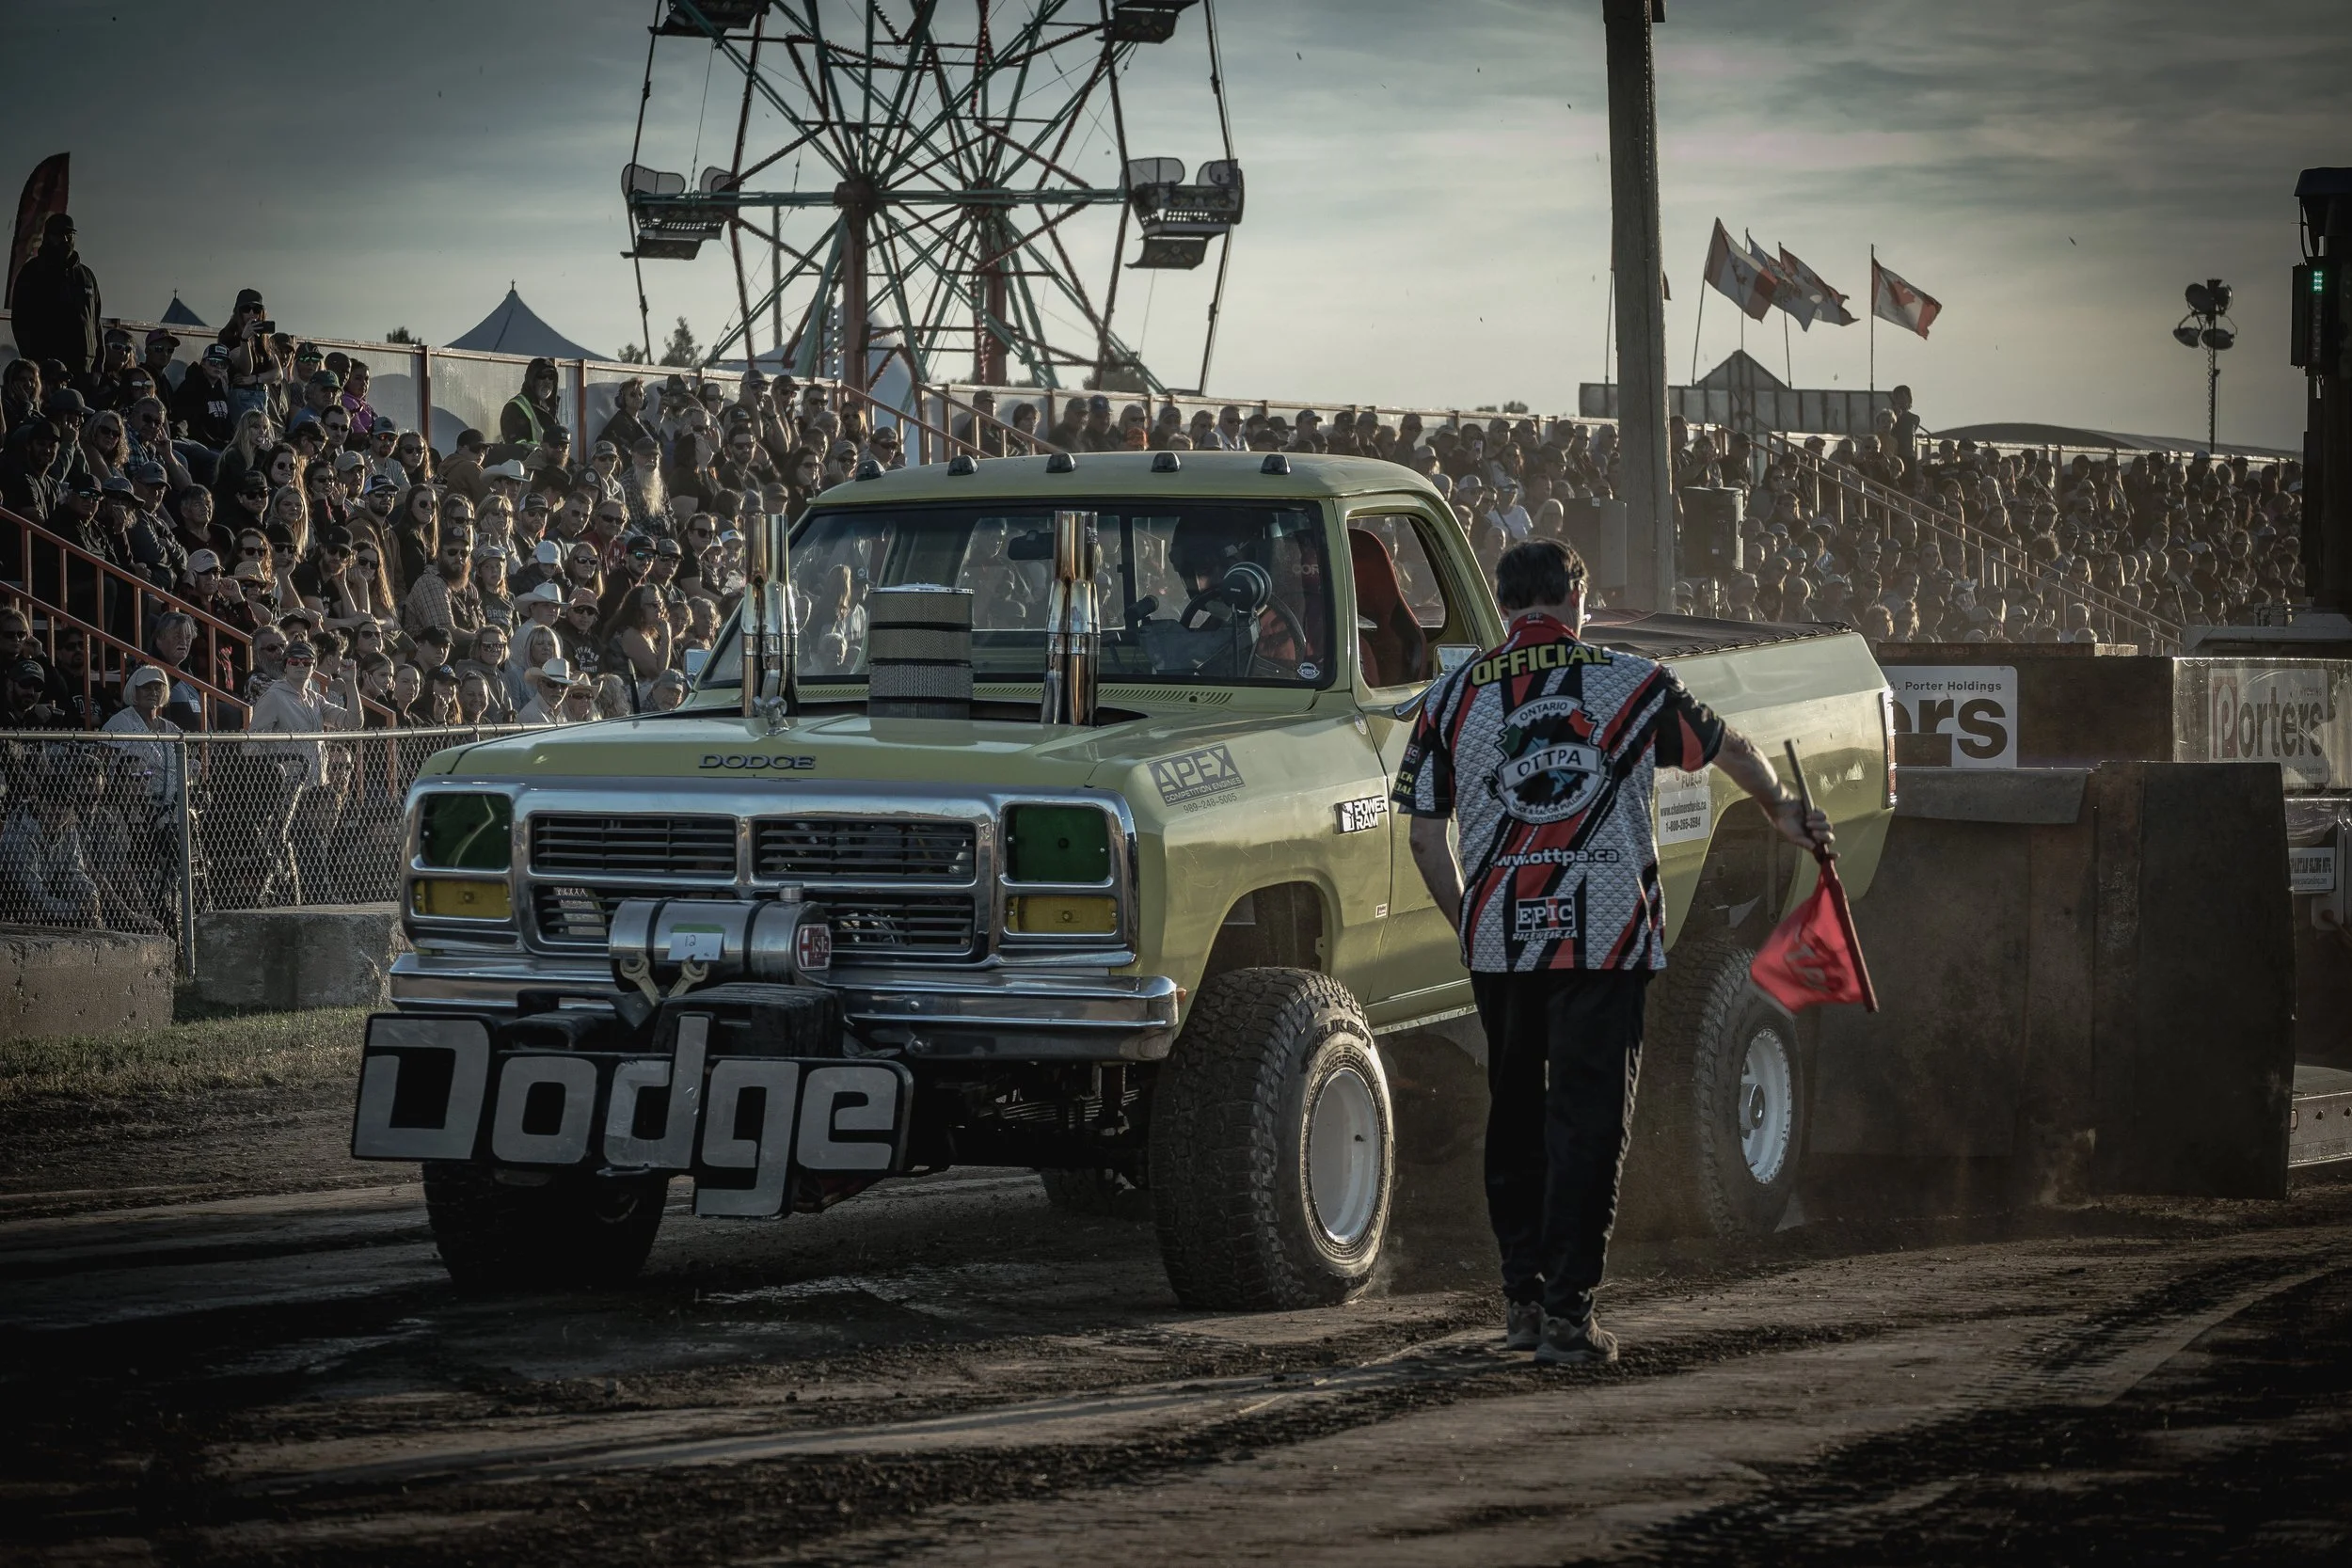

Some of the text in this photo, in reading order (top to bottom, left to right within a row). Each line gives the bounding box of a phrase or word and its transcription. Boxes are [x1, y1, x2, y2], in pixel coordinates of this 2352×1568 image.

[1471, 643, 1611, 686] OFFICIAL
[1905, 681, 1943, 691] Porter
[1947, 681, 2002, 693] Holdings
[1518, 702, 1567, 721] ONTARIO
[2213, 676, 2324, 758] Porters
[698, 753, 816, 770] DODGE
[1156, 748, 1237, 794] APEX
[1517, 750, 1581, 777] OTTPA
[1164, 776, 1242, 803] COMPETITION ENGINES
[1183, 792, 1238, 814] 989-248-5005
[1353, 798, 1388, 816] POWER
[1355, 812, 1379, 831] RAM
[1518, 904, 1573, 926] EPIC
[352, 1011, 899, 1217] Dodge
